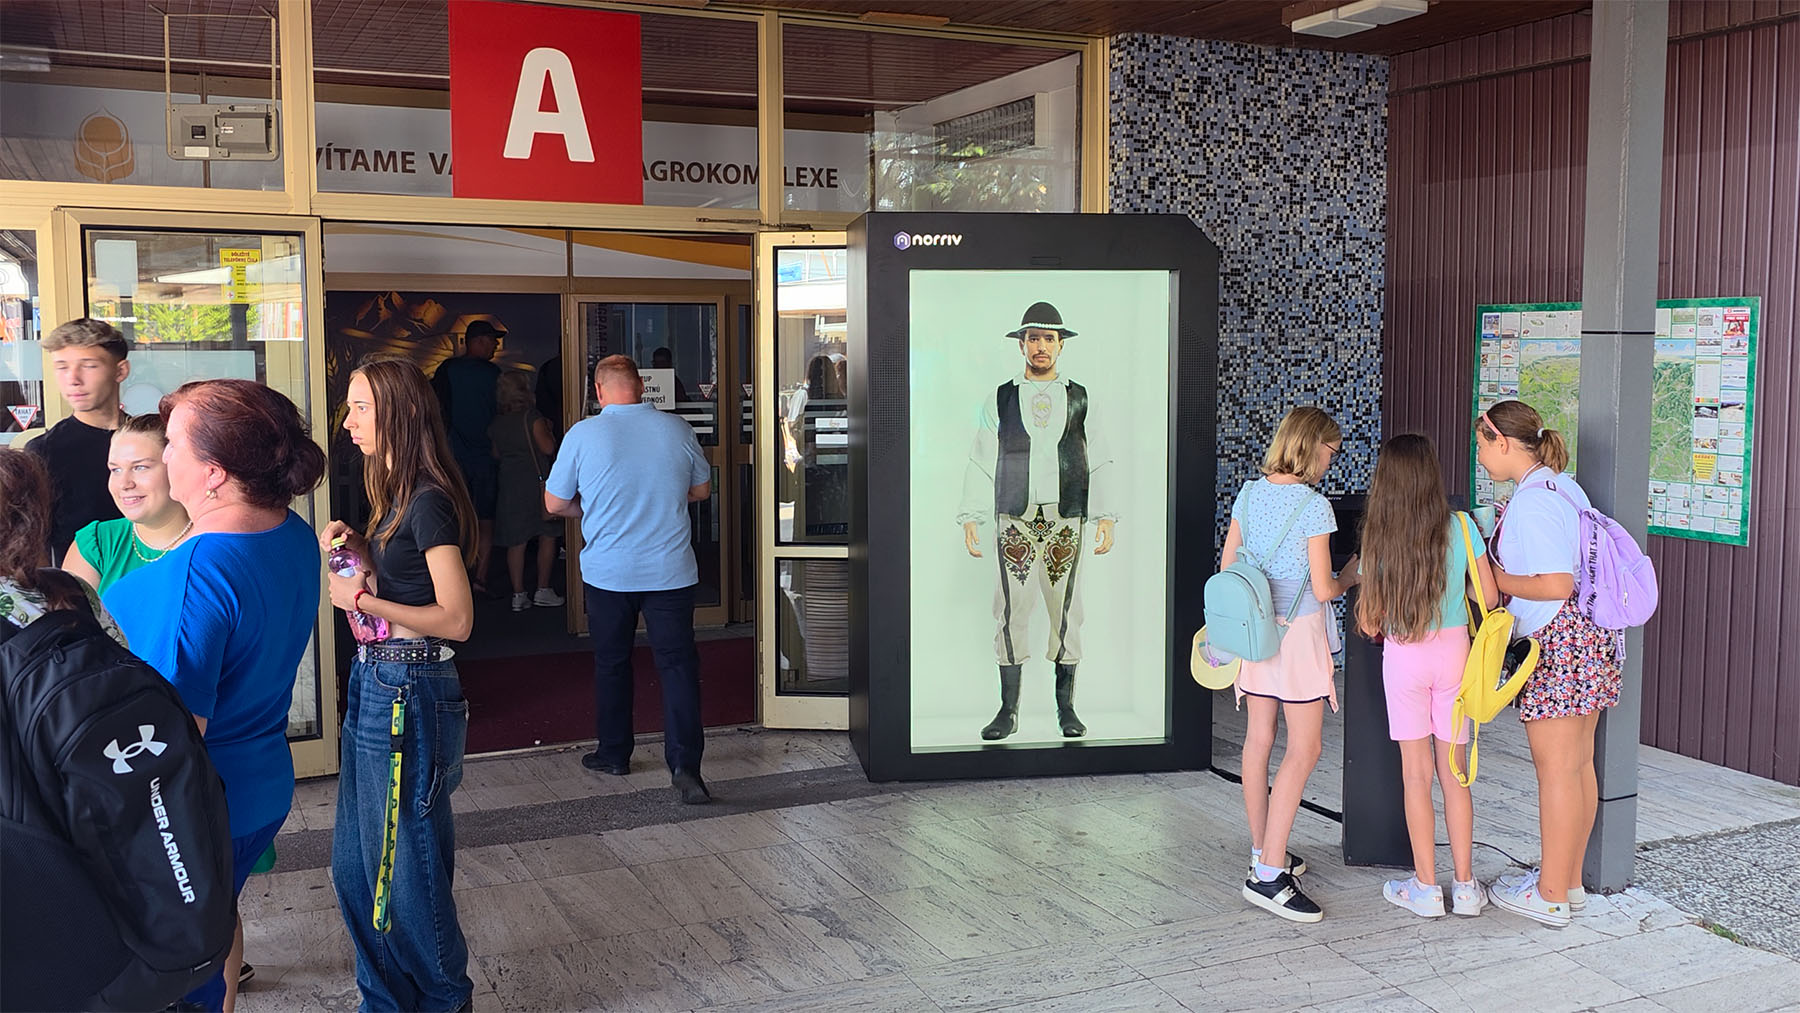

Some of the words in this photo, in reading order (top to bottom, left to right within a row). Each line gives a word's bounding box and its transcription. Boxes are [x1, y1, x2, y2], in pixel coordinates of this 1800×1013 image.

[503, 47, 595, 163] A
[428, 152, 453, 175] V
[912, 234, 963, 246] norriv
[150, 777, 169, 829] UNDER
[160, 832, 196, 904] ARMOUR
